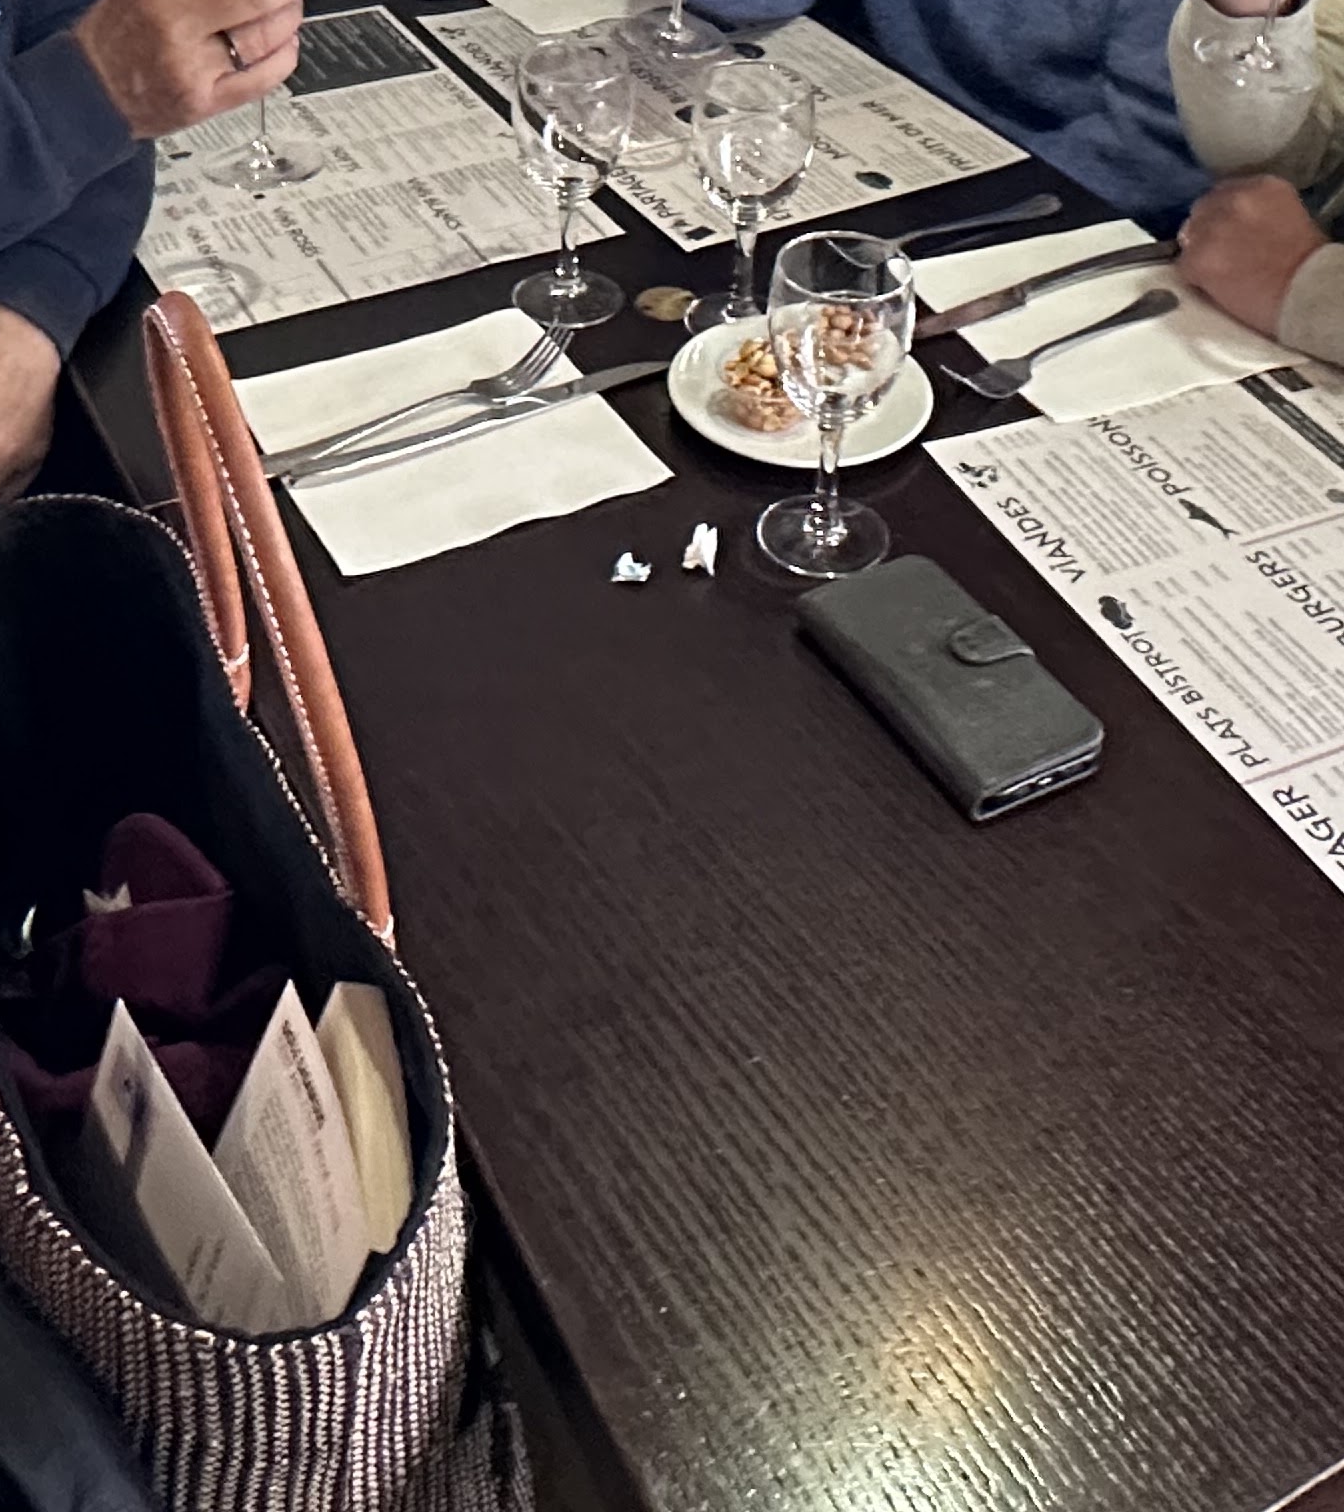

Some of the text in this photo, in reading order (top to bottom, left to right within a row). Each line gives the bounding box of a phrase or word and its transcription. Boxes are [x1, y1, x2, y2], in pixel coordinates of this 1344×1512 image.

[997, 497, 1085, 583] VIANDES
[1121, 631, 1269, 767] PLATS BISTROT
